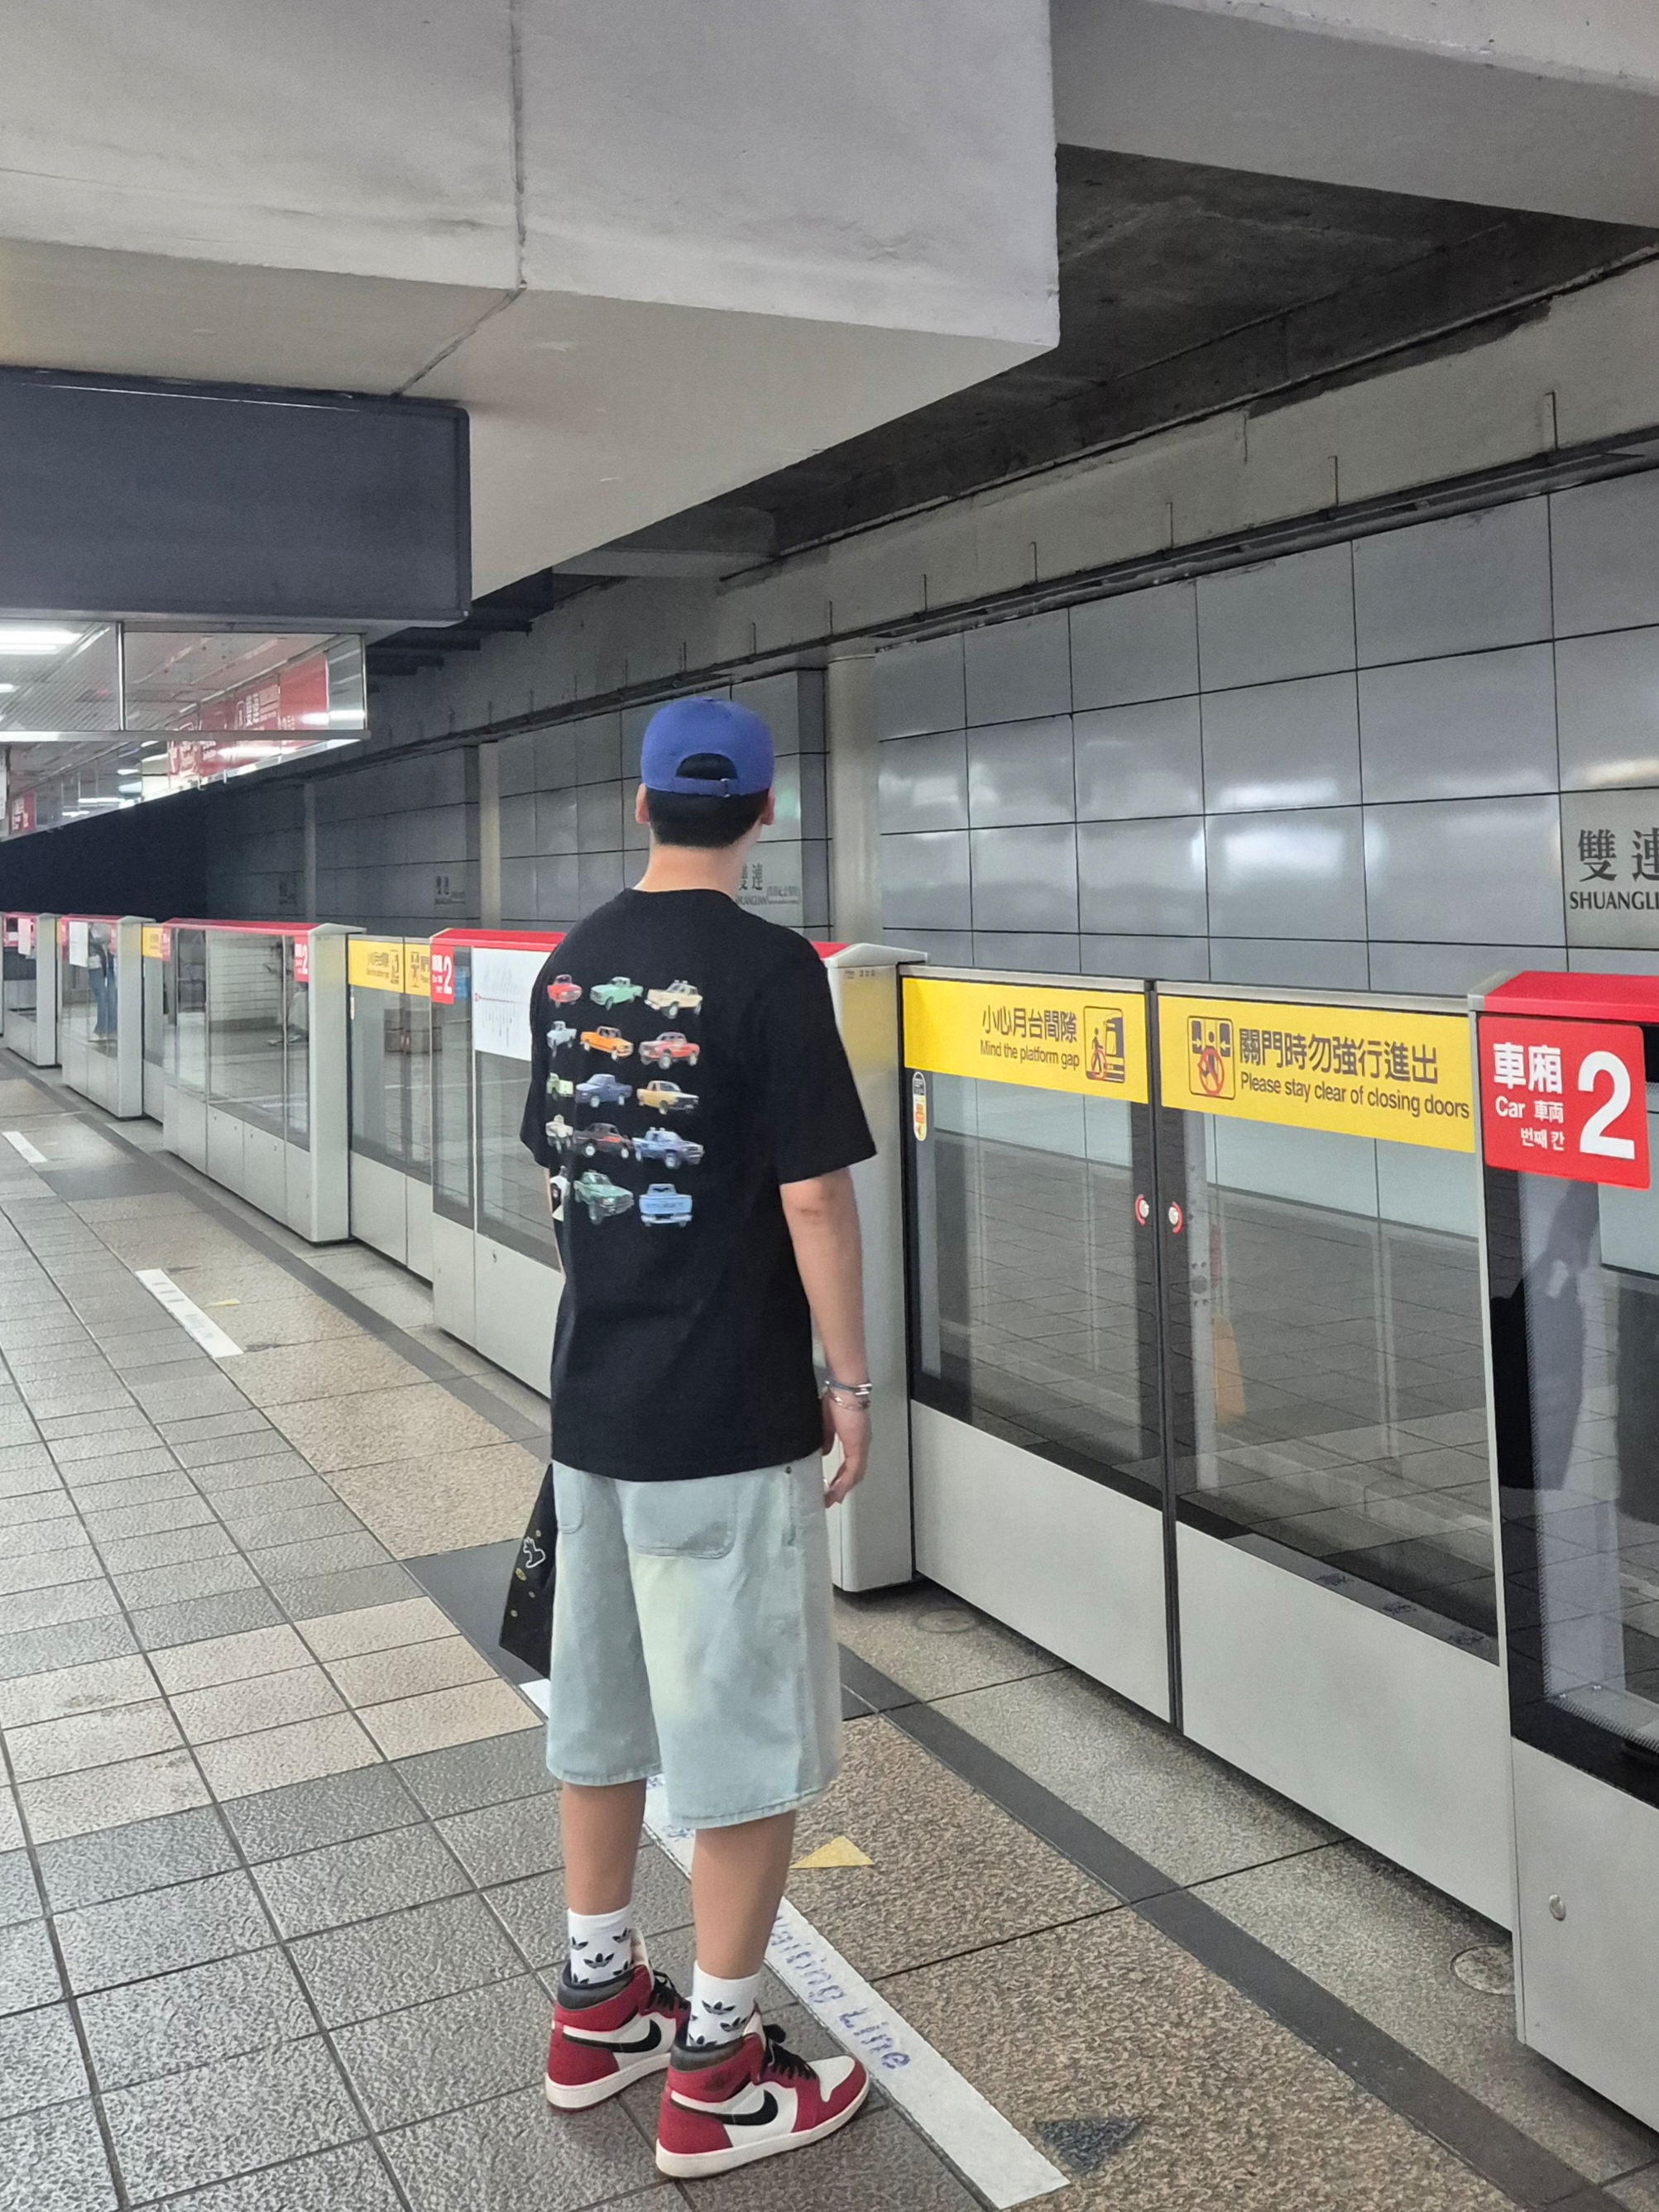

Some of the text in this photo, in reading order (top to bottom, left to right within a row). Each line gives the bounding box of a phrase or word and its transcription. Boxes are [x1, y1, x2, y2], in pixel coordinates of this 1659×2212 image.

[1578, 827, 1659, 883] 雙連
[444, 955, 453, 995] 2
[981, 1004, 1077, 1043] 小心月台間隙
[981, 1039, 1080, 1071] Mind the platform gap
[1239, 1027, 1439, 1084] 關門時勿強行進出
[1493, 1041, 1563, 1094] 車廂
[1240, 1070, 1470, 1119] Please stay clear of closing doors
[1495, 1095, 1526, 1118] Car
[1577, 1051, 1636, 1161] 2
[1520, 1127, 1566, 1151] 번째 칸
[838, 2007, 911, 2069] Line
